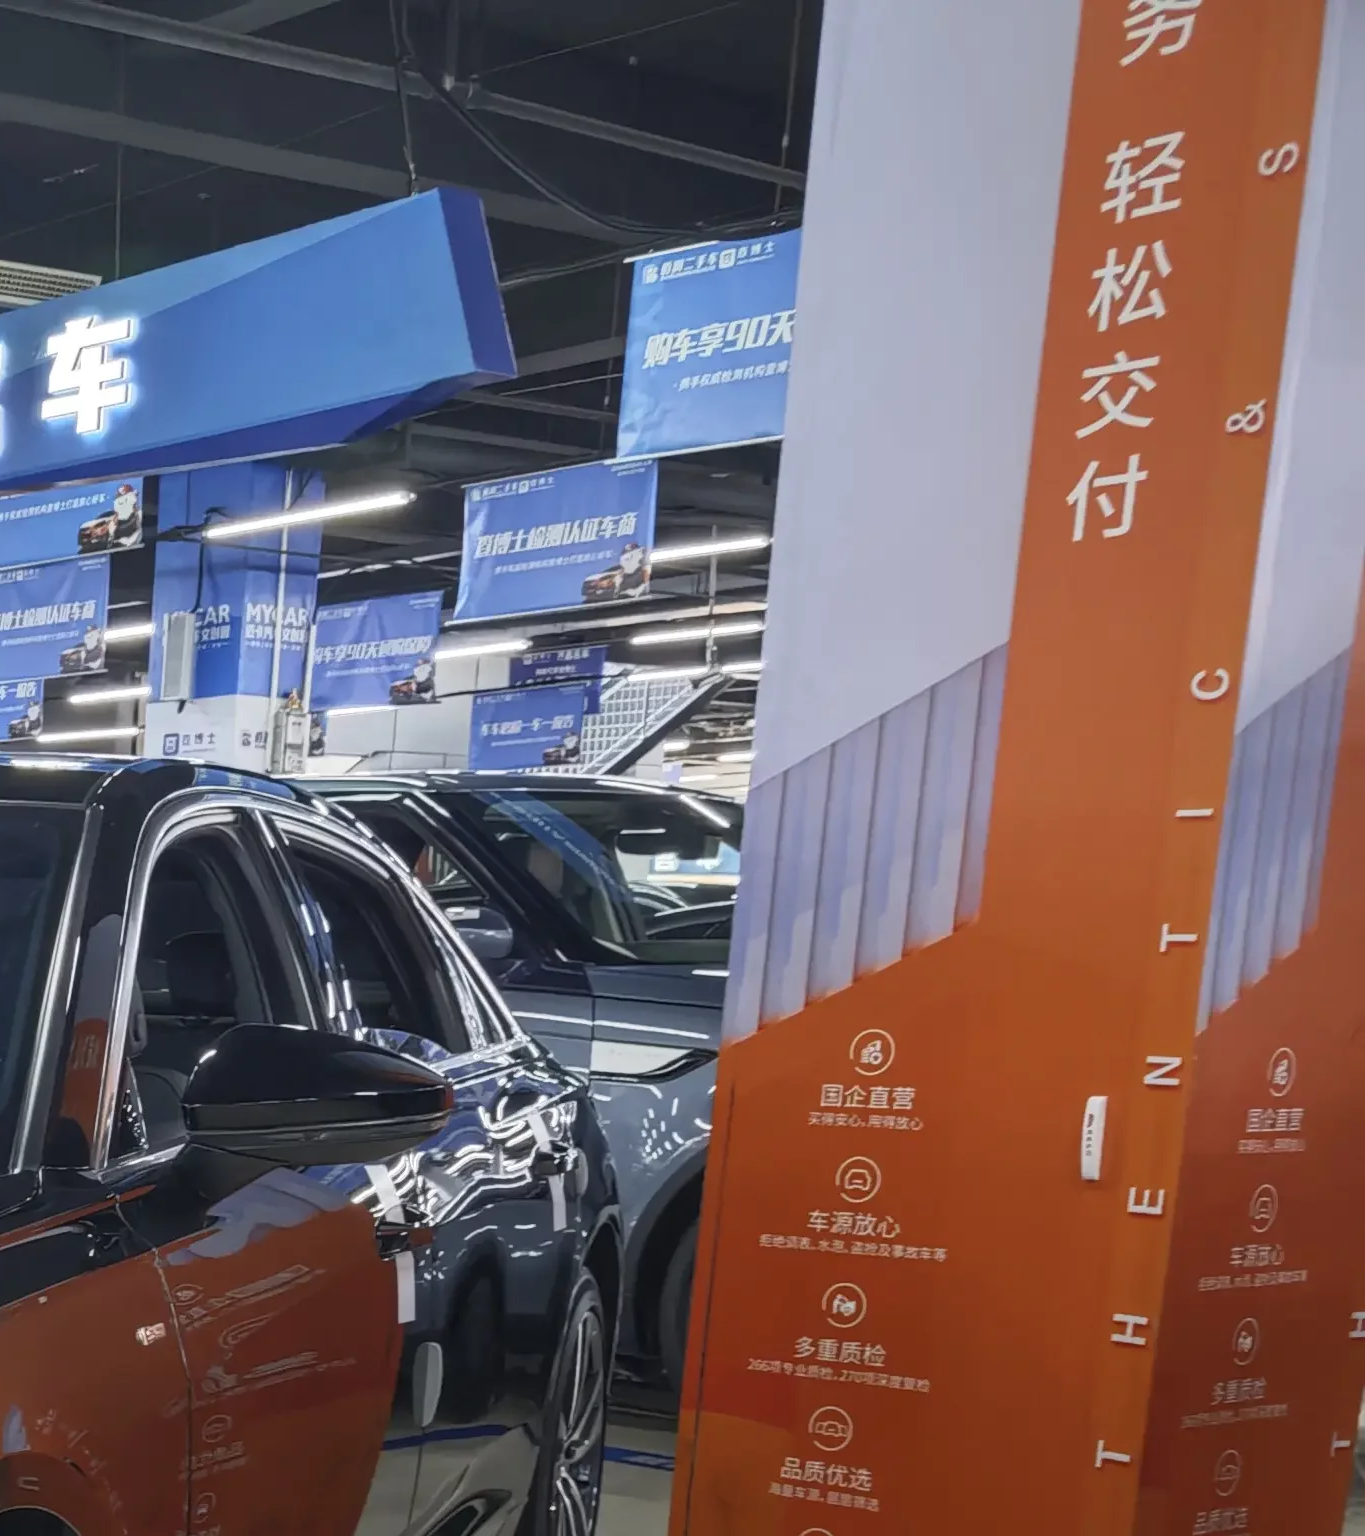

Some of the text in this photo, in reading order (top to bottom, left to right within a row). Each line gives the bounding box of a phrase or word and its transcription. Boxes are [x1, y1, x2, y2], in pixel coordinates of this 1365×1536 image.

[1065, 129, 1186, 542] 轻松交付
[1225, 398, 1267, 434] &
[820, 1083, 917, 1110] 国企直营
[807, 1209, 902, 1239] 车源放心
[793, 1336, 887, 1367] 多重质检
[780, 1456, 873, 1492] 品质优选
